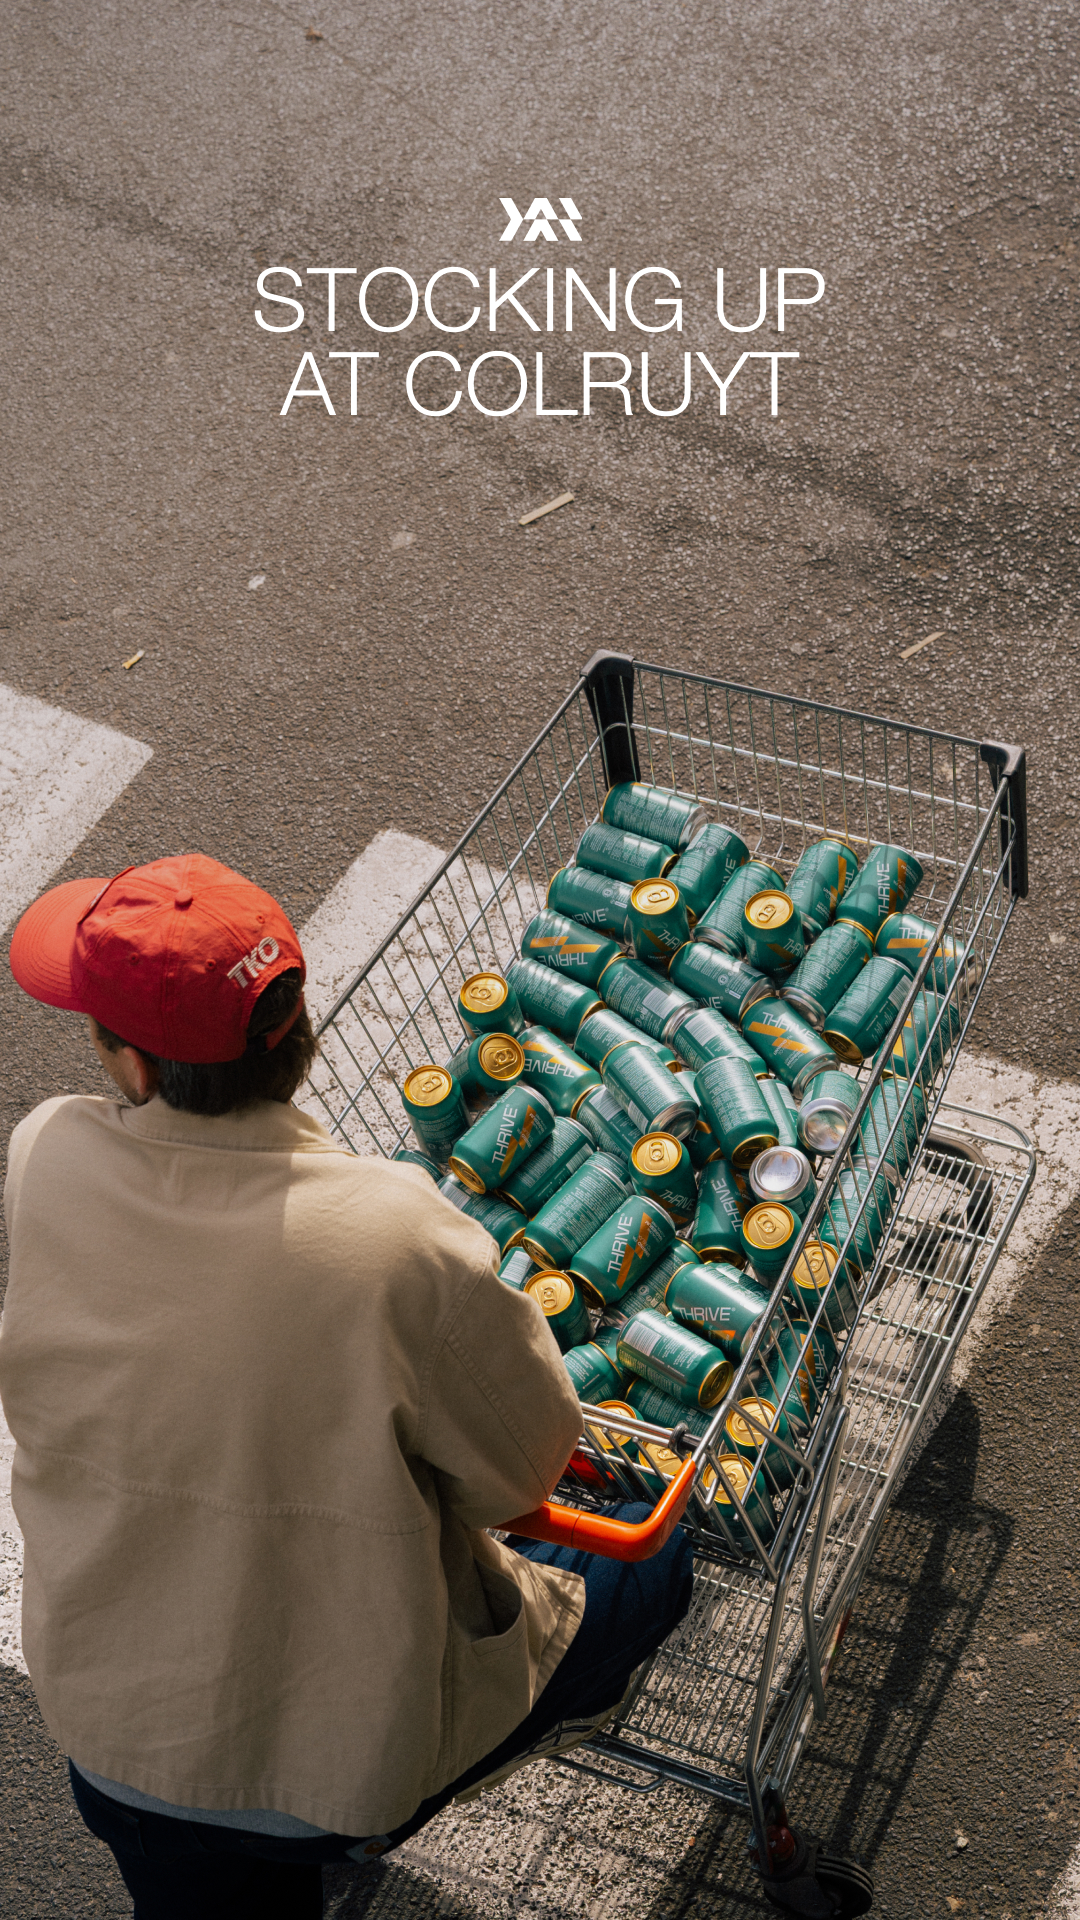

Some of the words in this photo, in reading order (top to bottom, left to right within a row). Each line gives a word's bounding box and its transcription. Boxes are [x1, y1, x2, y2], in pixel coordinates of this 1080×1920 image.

[876, 863, 891, 916] THRIVE
[226, 936, 280, 989] TKO
[762, 1011, 817, 1041] THRIVE
[523, 1058, 575, 1078] THRIVE
[491, 1107, 518, 1163] THRIVE
[711, 1178, 743, 1233] THRIVE
[606, 1216, 633, 1273] THRIVE
[675, 1307, 731, 1321] THRIVE
